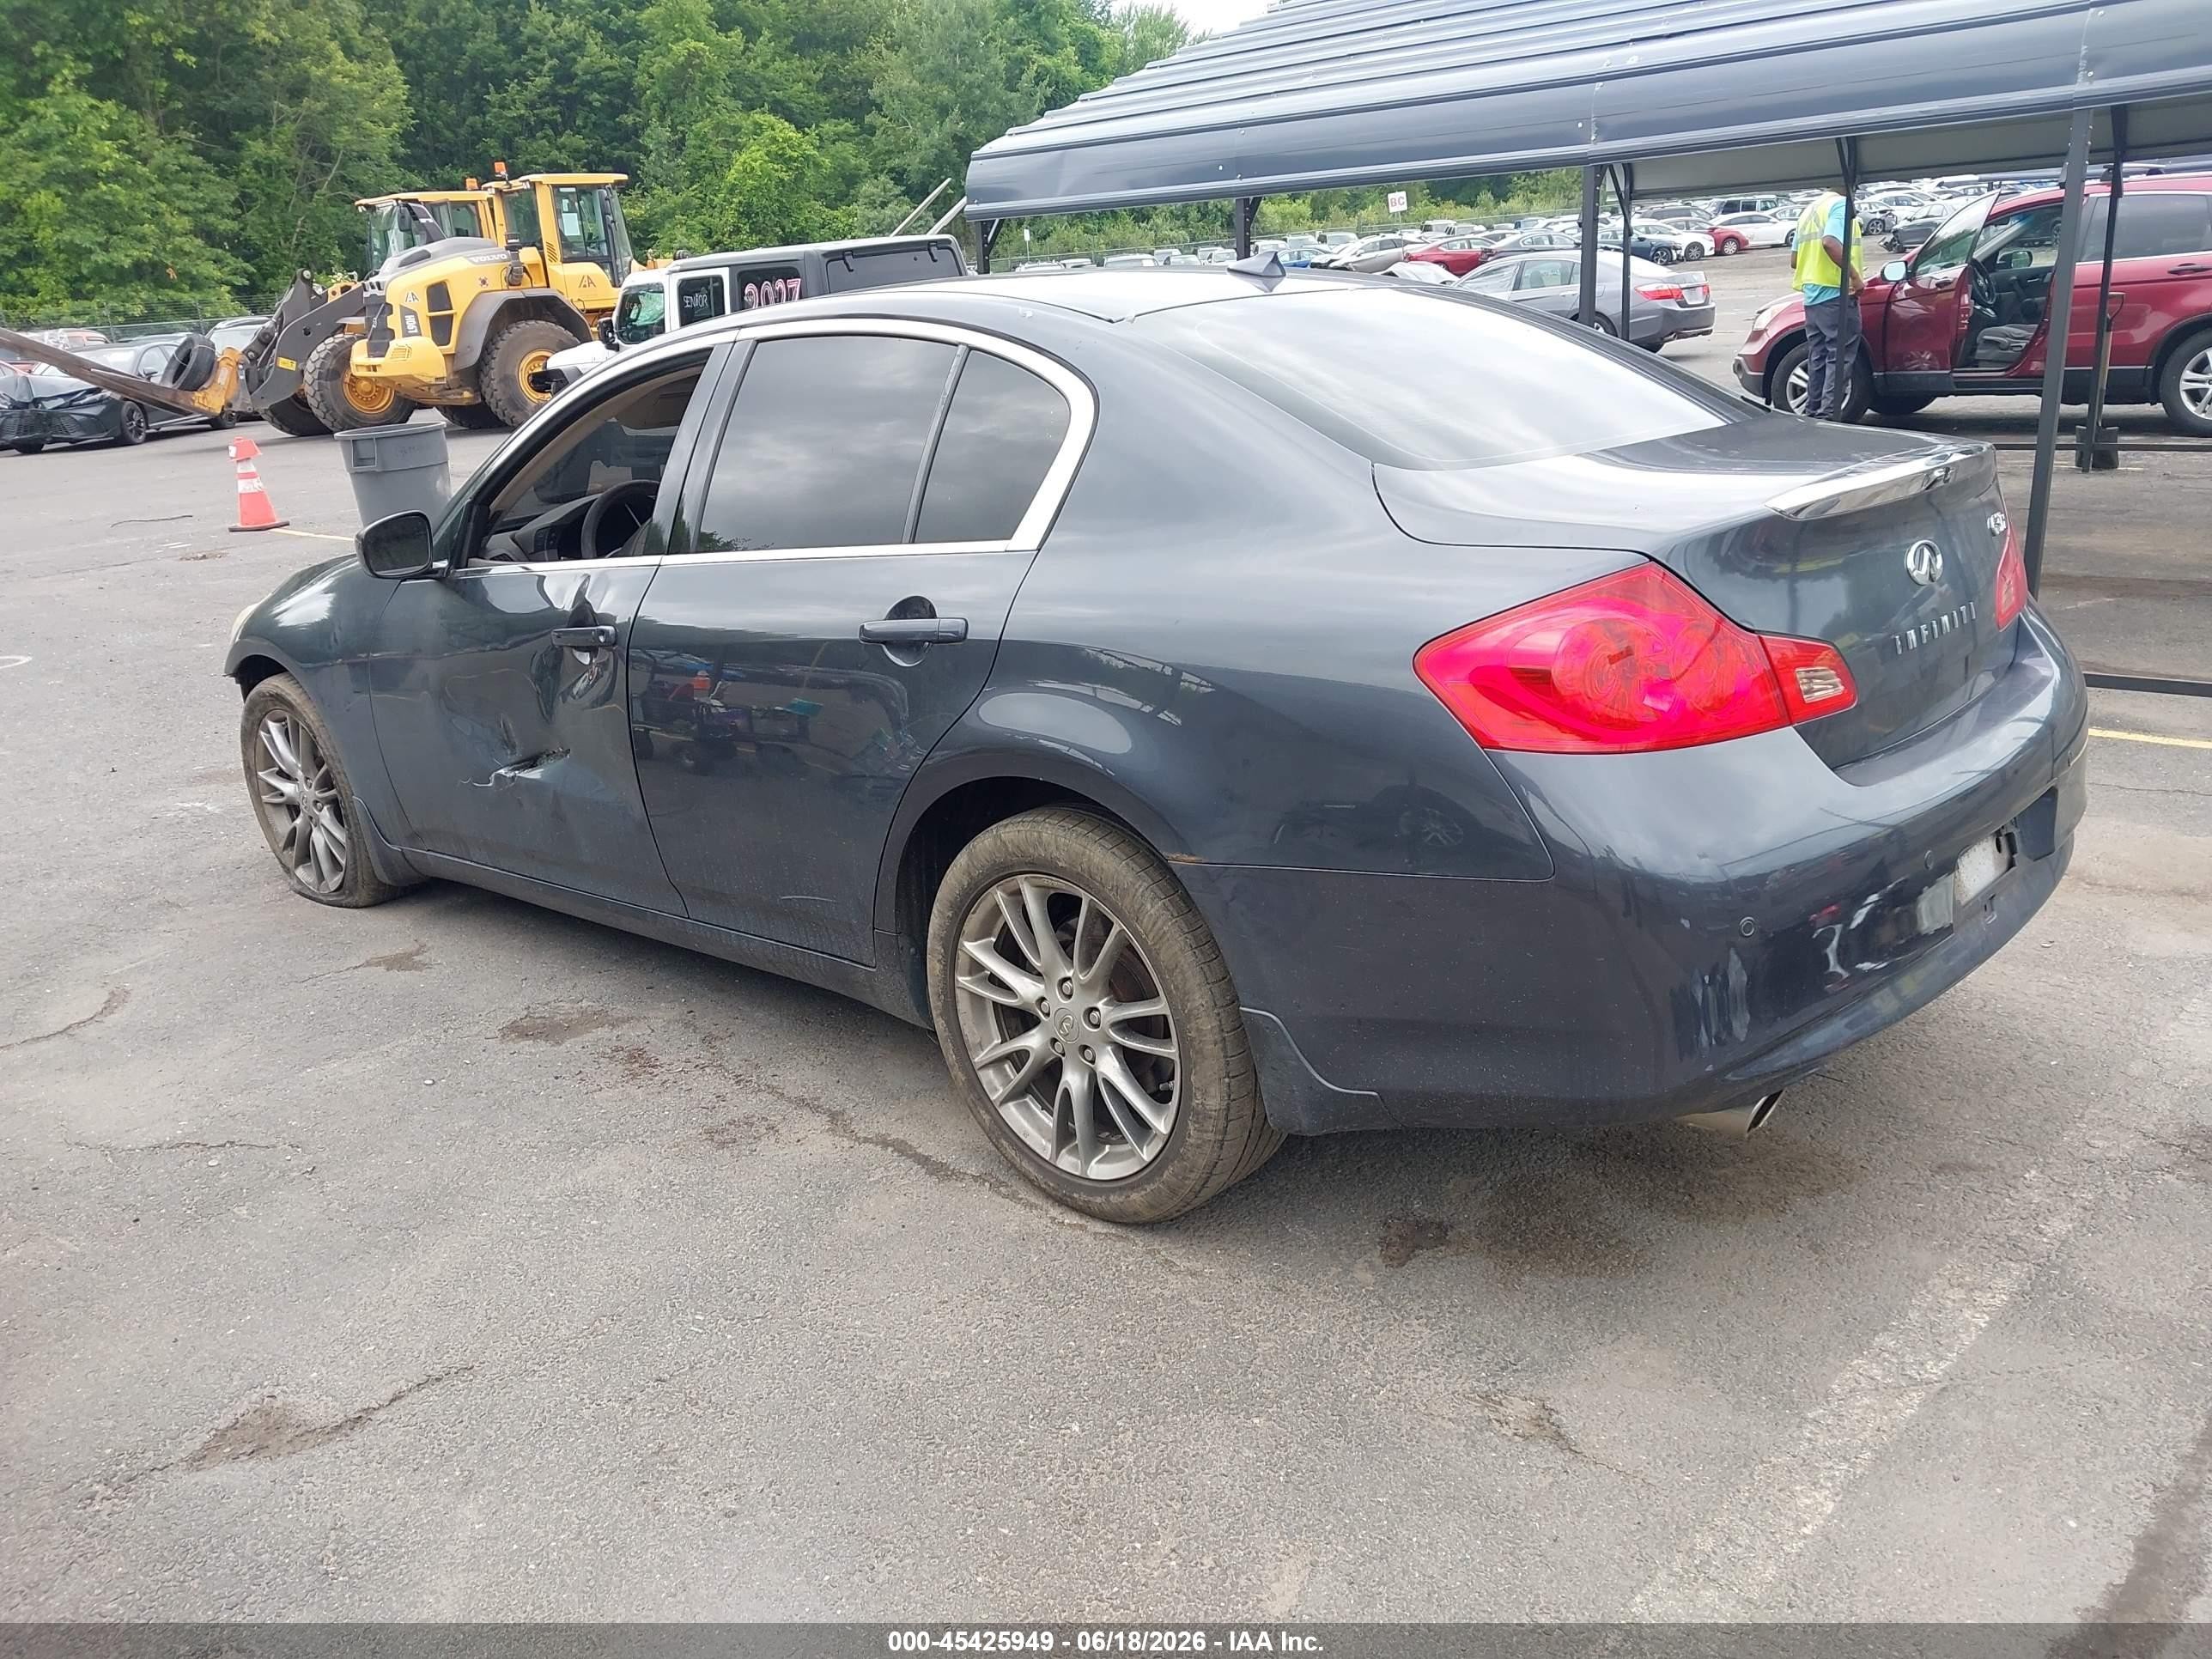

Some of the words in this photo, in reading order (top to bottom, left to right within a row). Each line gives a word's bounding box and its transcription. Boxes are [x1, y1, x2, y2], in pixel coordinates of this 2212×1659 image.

[1390, 197, 1405, 207] BC
[469, 253, 507, 263] VOLVO
[1894, 602, 1976, 654] INFINITI
